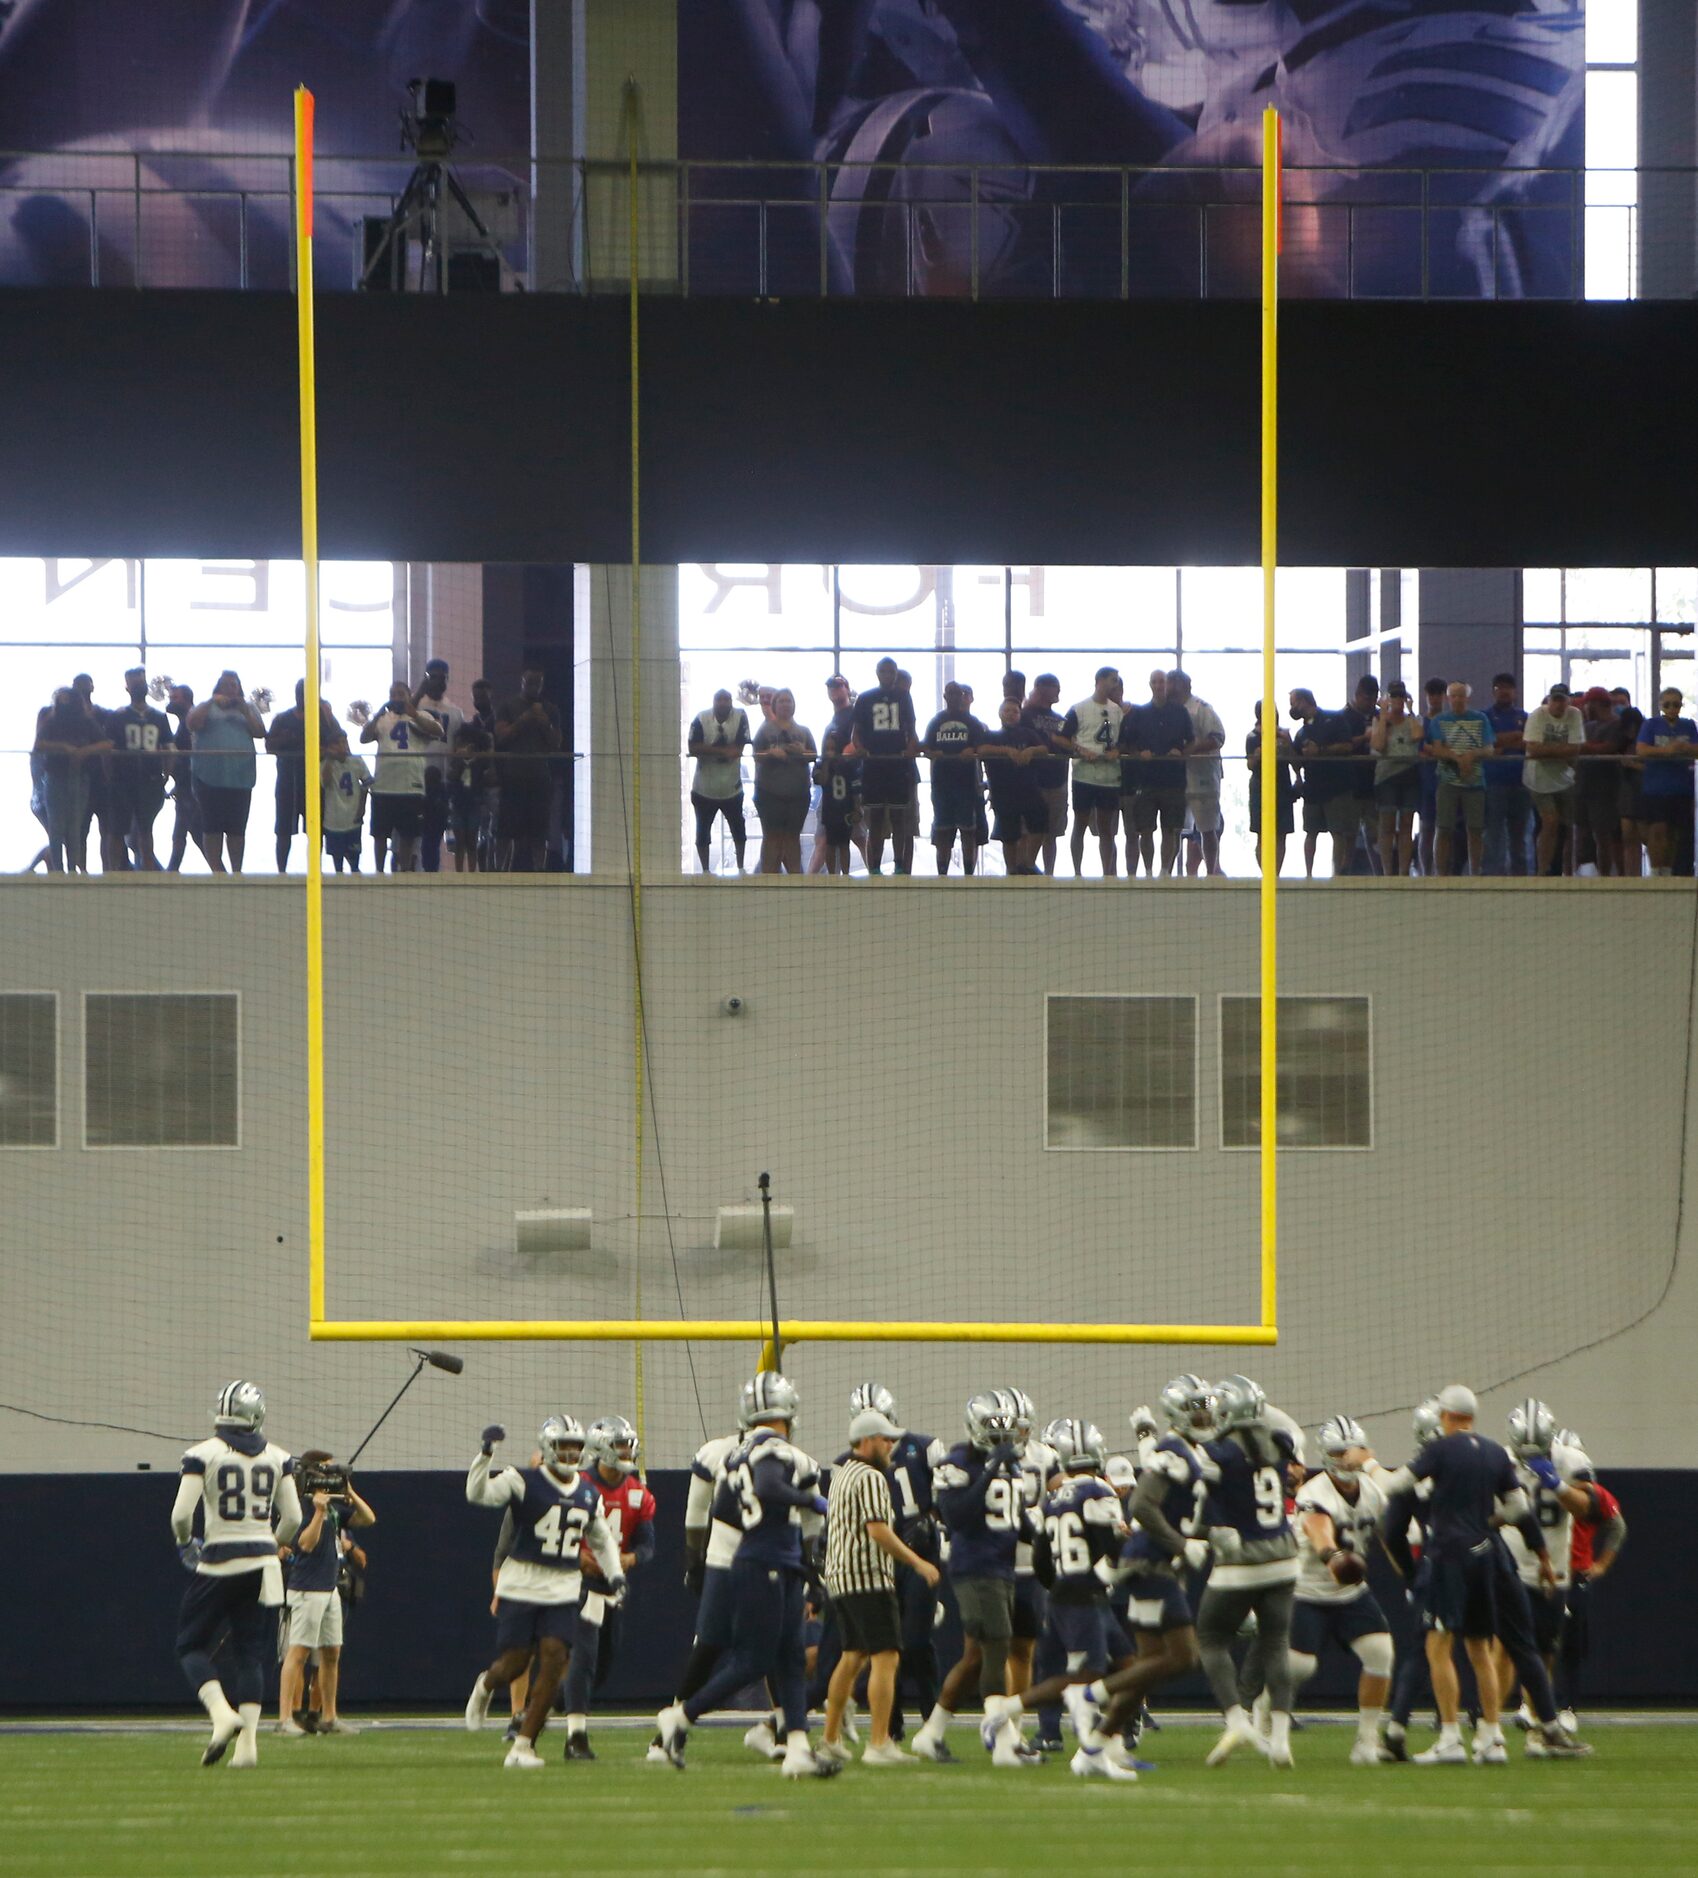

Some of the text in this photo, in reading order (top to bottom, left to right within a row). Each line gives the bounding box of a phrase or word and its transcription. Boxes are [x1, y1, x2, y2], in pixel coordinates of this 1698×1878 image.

[872, 702, 900, 731] 21
[389, 720, 408, 750] 4
[1093, 719, 1113, 752] 4
[339, 771, 353, 797] 4
[832, 774, 847, 800] 8
[217, 1464, 275, 1521] 89
[1253, 1465, 1283, 1529] 9
[534, 1504, 590, 1560] 42
